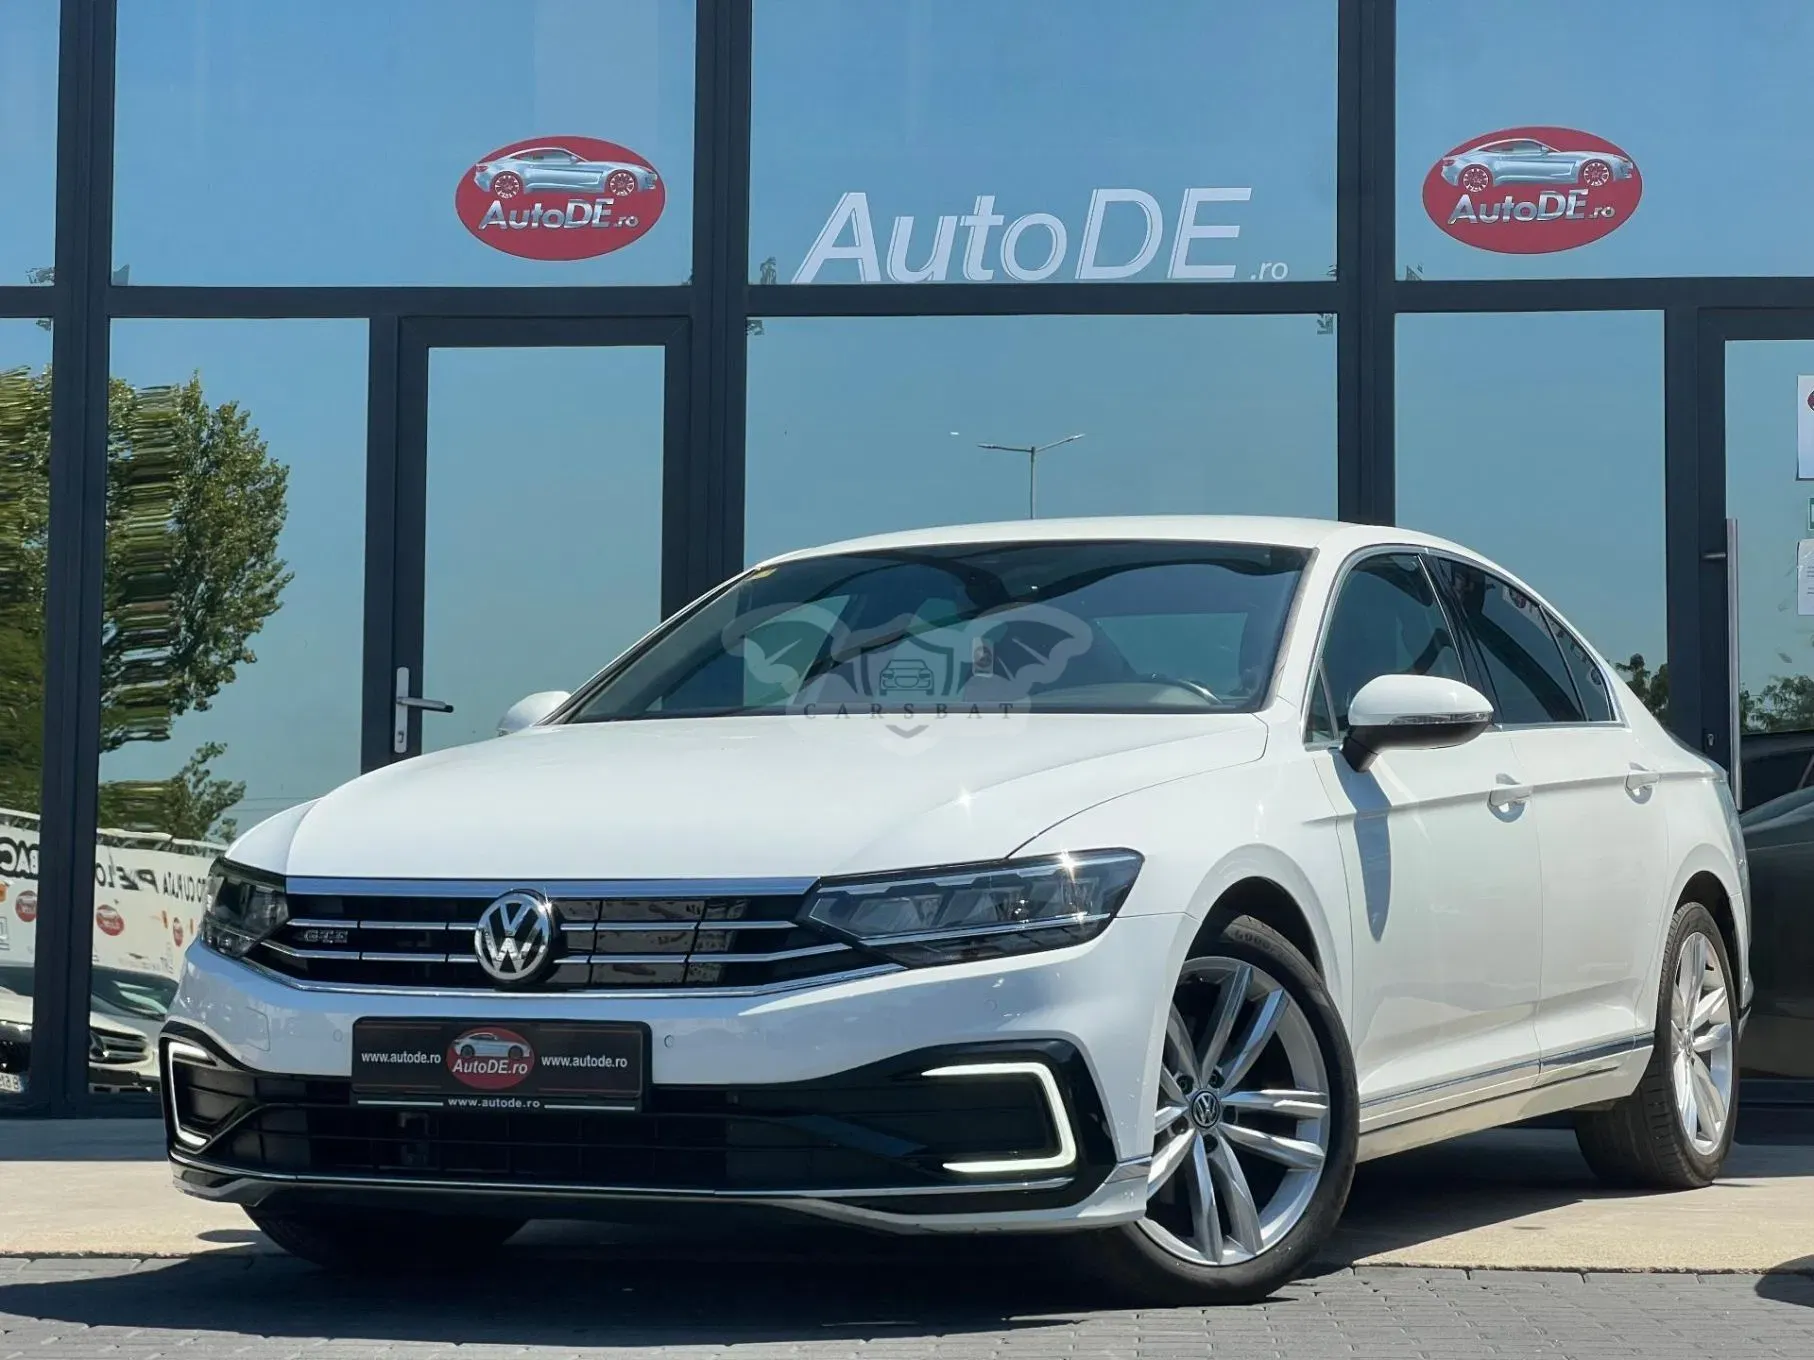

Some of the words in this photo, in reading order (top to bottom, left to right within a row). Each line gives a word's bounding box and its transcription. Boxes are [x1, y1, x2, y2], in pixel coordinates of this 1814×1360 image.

[361, 1051, 441, 1064] www.autode.ro
[452, 1058, 528, 1075] AutoDE.ro
[541, 1055, 628, 1068] www.autode.ro
[448, 1097, 540, 1108] www.autode.ro
